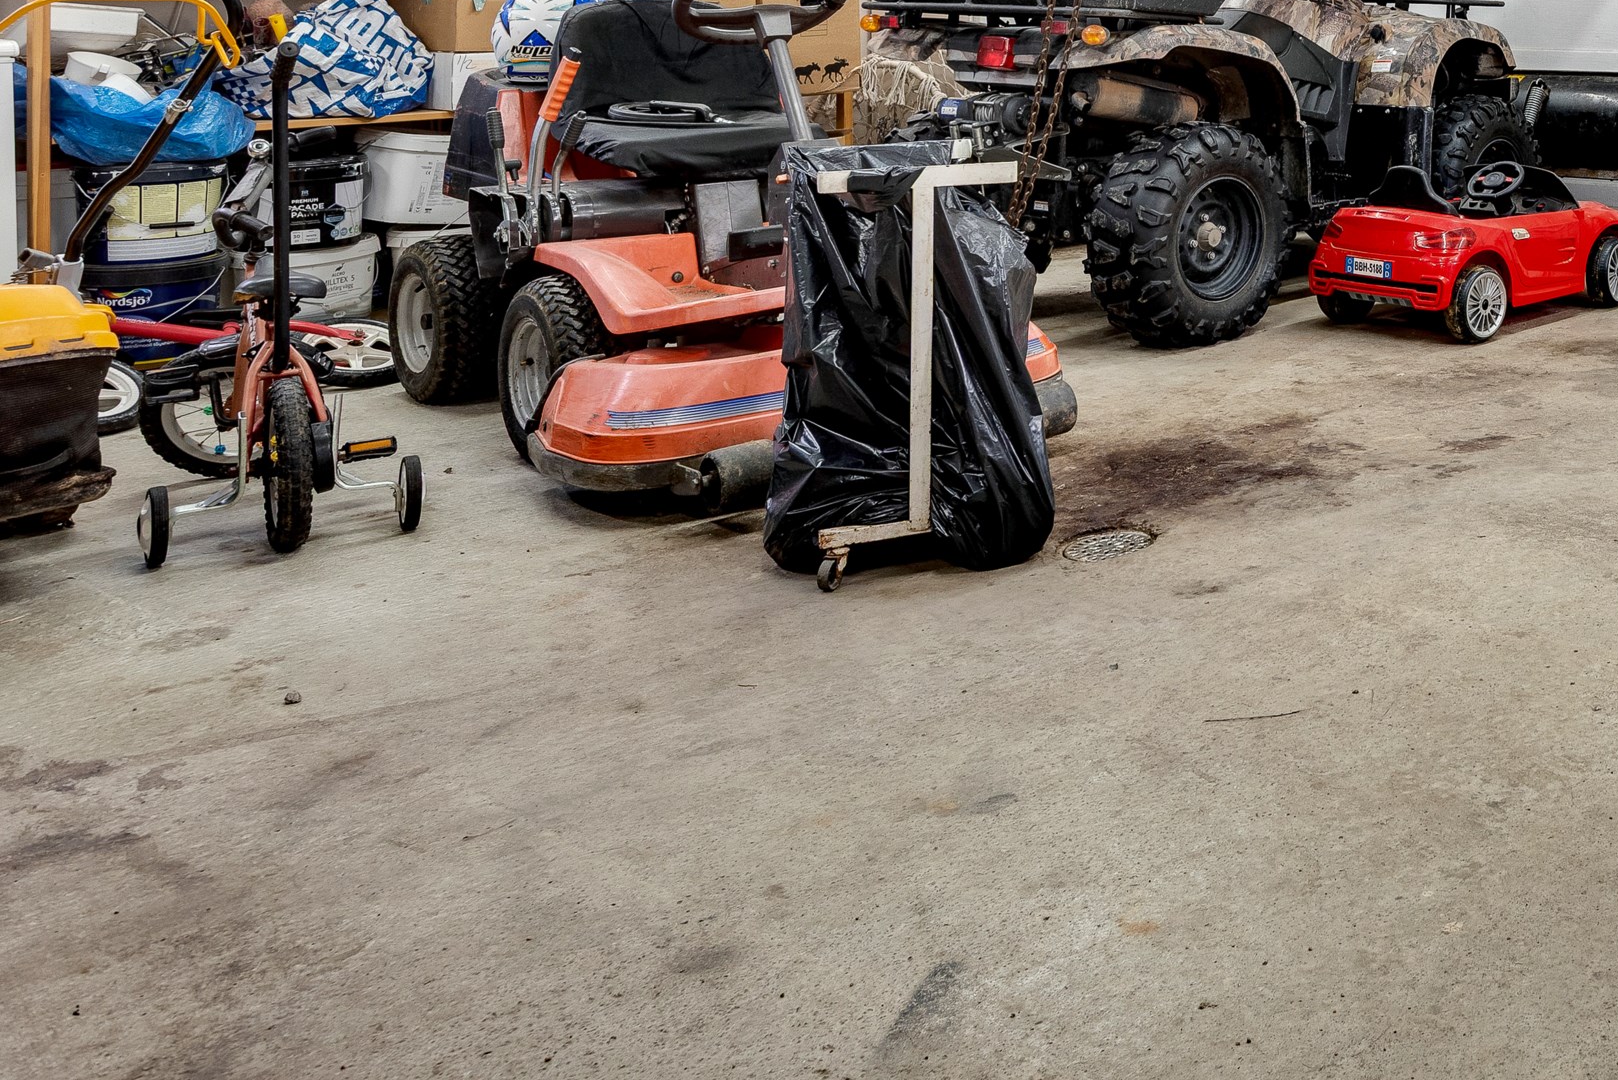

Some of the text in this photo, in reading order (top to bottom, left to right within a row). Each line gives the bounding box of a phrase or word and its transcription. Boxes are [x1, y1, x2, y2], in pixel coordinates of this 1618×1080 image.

[510, 45, 553, 58] NOLA
[291, 197, 319, 205] PREMIUM
[1354, 260, 1383, 275] BBH-5188
[350, 274, 356, 282] 5
[97, 296, 146, 308] Nordsjö
